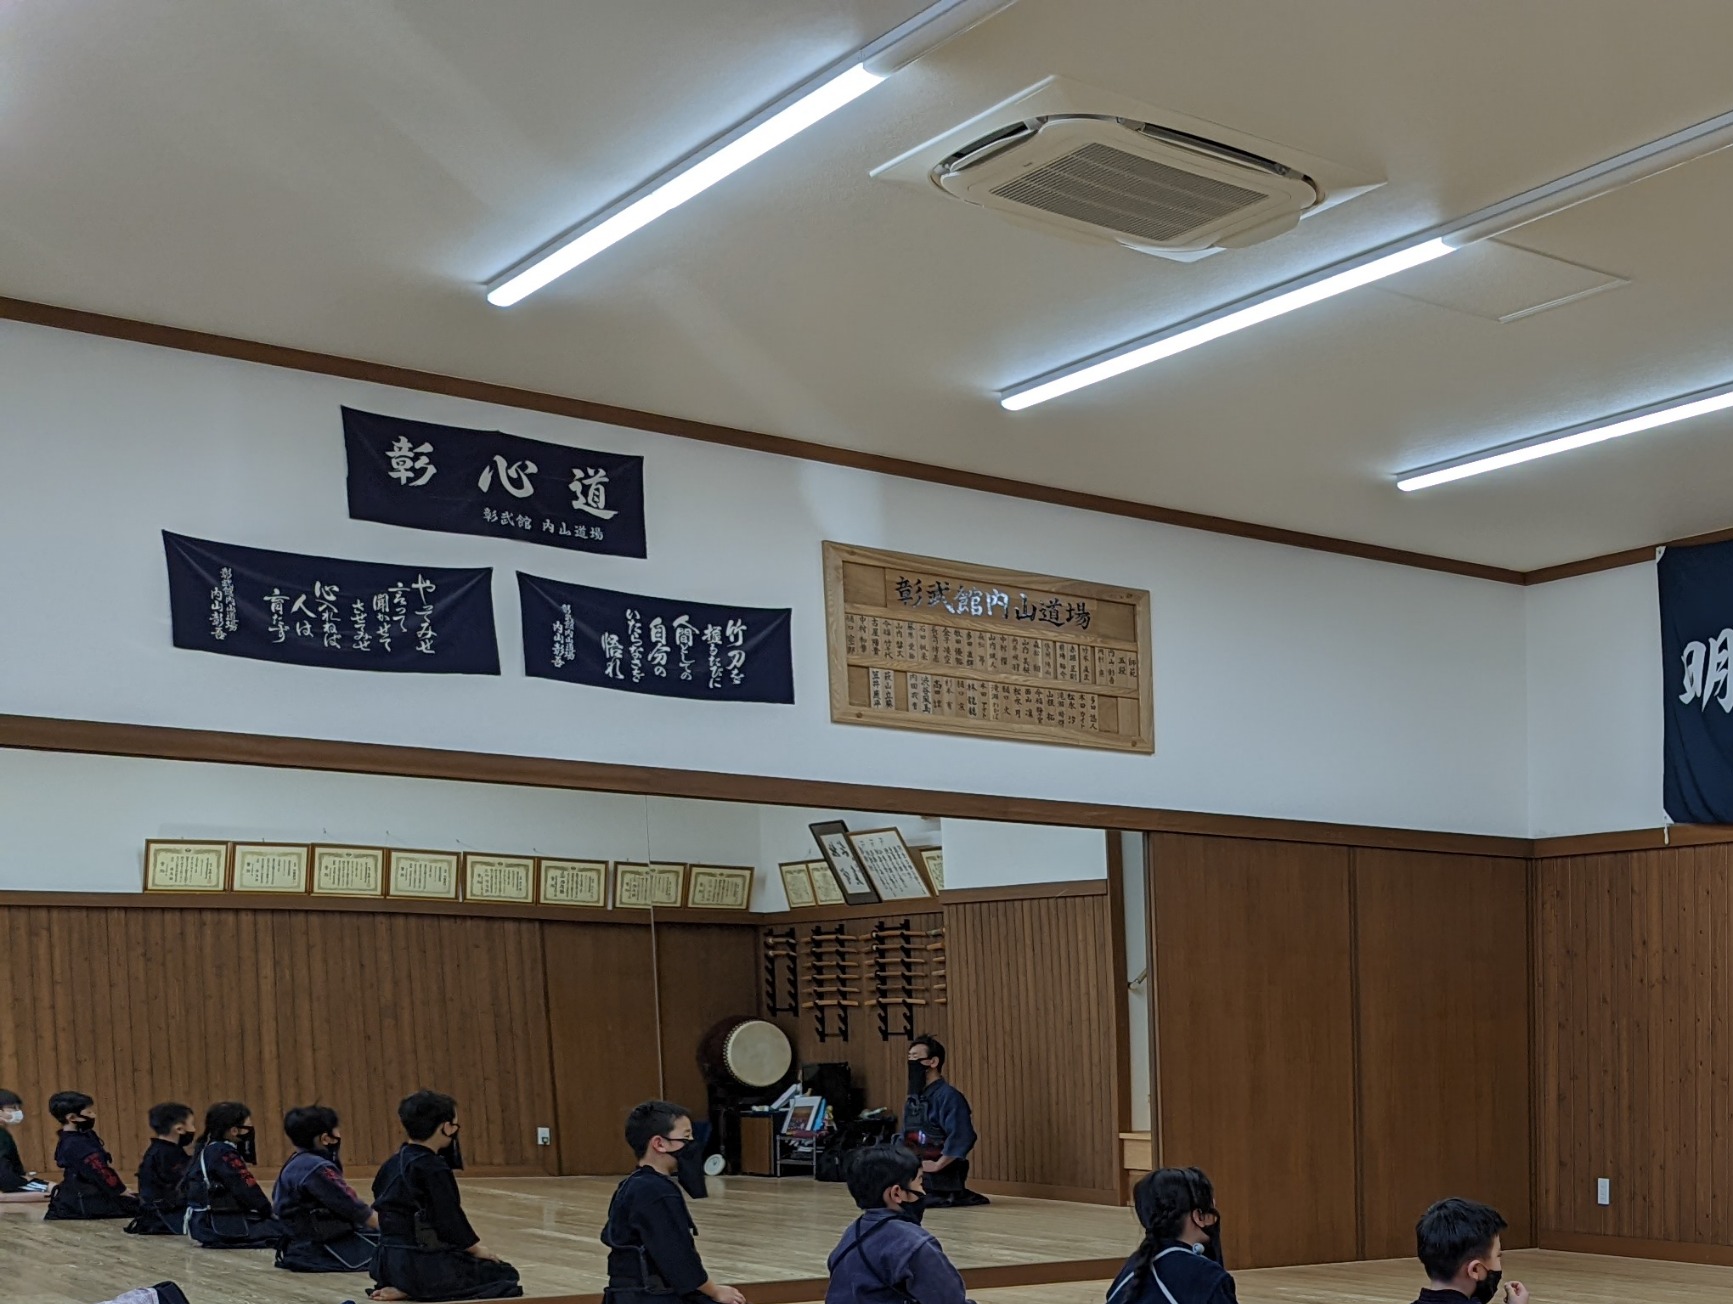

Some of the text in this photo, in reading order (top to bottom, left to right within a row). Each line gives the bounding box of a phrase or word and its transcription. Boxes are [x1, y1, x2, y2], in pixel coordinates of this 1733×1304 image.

[385, 435, 619, 521] 彰心道
[483, 507, 604, 541] 彰武館 内山道場
[290, 594, 317, 638] 人は
[372, 593, 392, 652] 聞かせて
[388, 582, 411, 632] 言って
[895, 576, 1091, 630] 彰武館内山道場
[601, 632, 625, 679] 悟れ
[648, 617, 671, 678] 自分の
[672, 615, 700, 681] 人間としての
[702, 624, 724, 688] 握るたびに
[725, 619, 748, 685] 竹刀を
